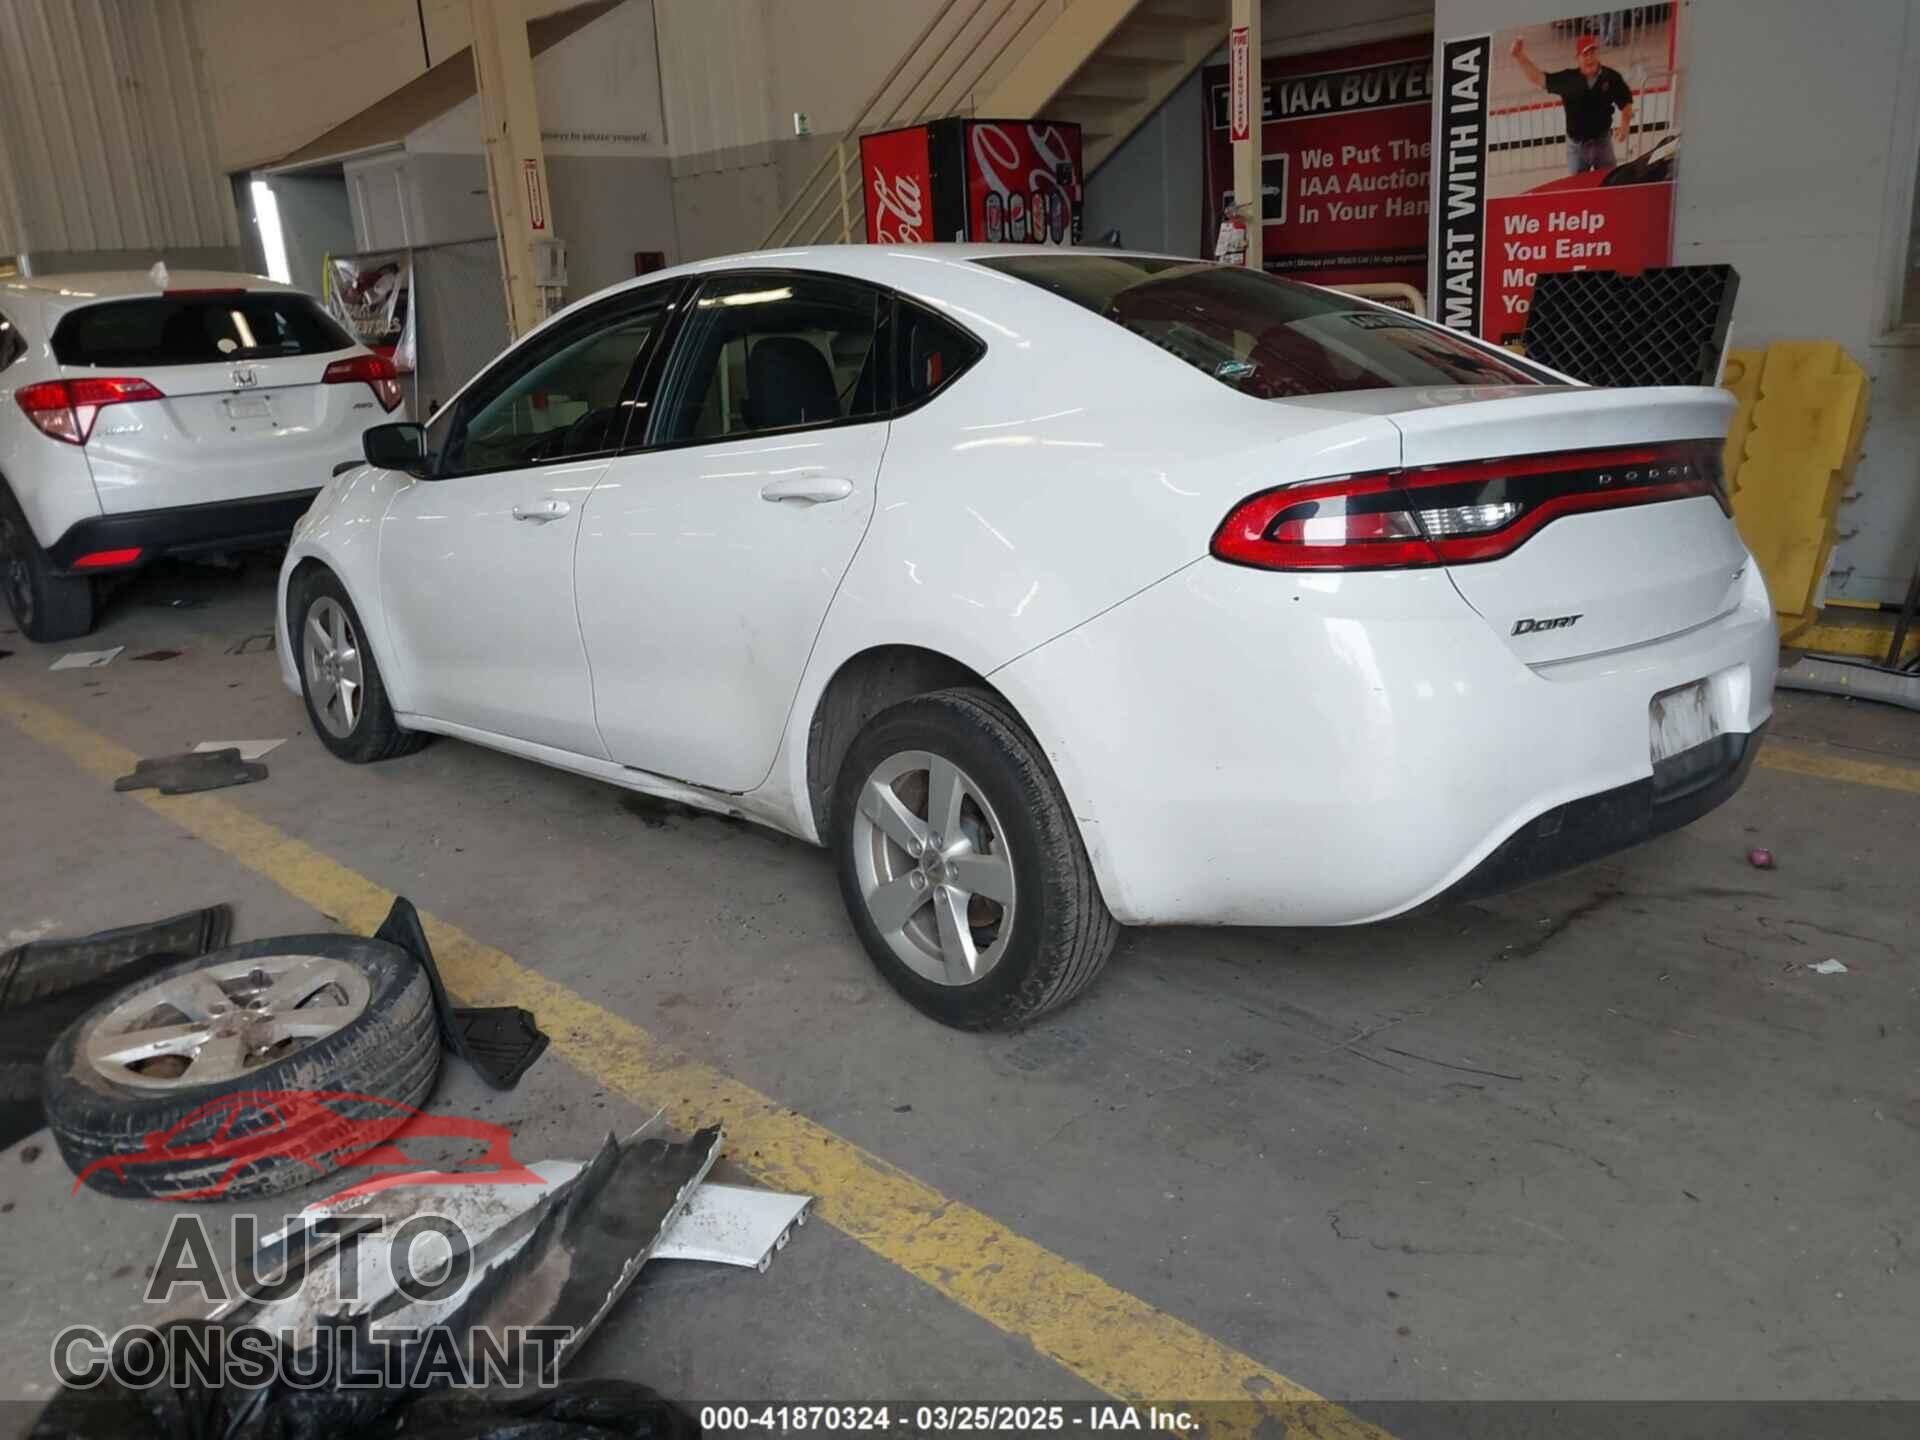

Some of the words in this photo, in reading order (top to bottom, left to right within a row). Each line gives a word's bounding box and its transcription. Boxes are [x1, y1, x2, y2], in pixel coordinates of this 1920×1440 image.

[1451, 47, 1481, 112] IAA
[1280, 79, 1331, 114] IAA
[1301, 151, 1333, 169] We
[1341, 146, 1381, 166] Put
[1388, 140, 1431, 159] The
[1300, 177, 1341, 196] IAA
[1346, 169, 1431, 192] Auction
[1448, 124, 1478, 220] WITH
[1299, 205, 1319, 224] In
[1327, 203, 1377, 219] Your
[1385, 198, 1430, 216] Han
[1503, 214, 1540, 235] We
[1548, 210, 1605, 233] Help
[1503, 242, 1547, 261] You
[1555, 239, 1612, 259] Earn
[1502, 269, 1537, 288] Mo
[1502, 295, 1529, 313] Yo
